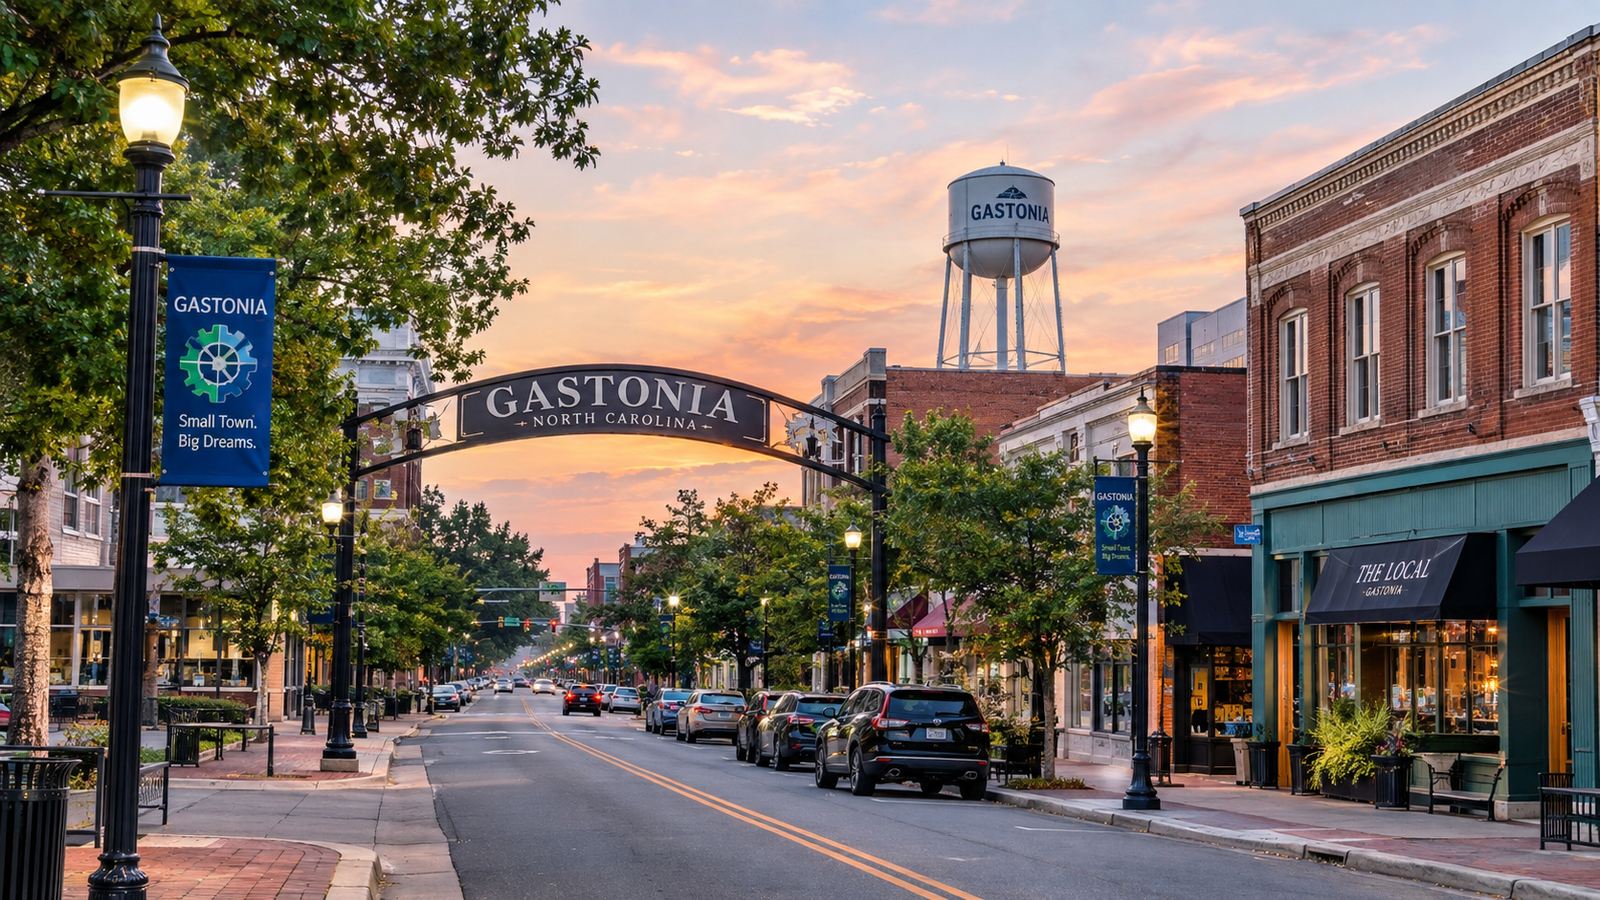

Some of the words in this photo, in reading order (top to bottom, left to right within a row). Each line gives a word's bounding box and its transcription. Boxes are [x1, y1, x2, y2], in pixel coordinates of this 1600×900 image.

[971, 202, 1049, 223] GASTONIA
[174, 296, 268, 315] GASTONIA
[486, 375, 739, 424] GASTONIA
[179, 414, 215, 428] Small
[218, 414, 257, 429] Town.
[533, 412, 595, 427] NORTH
[605, 412, 697, 430] CAROLINA
[178, 433, 200, 451] Big
[203, 434, 257, 449] Dreams.
[1096, 492, 1134, 501] GASTONIA
[1356, 563, 1386, 584] THE
[1384, 558, 1431, 581] LOCAL
